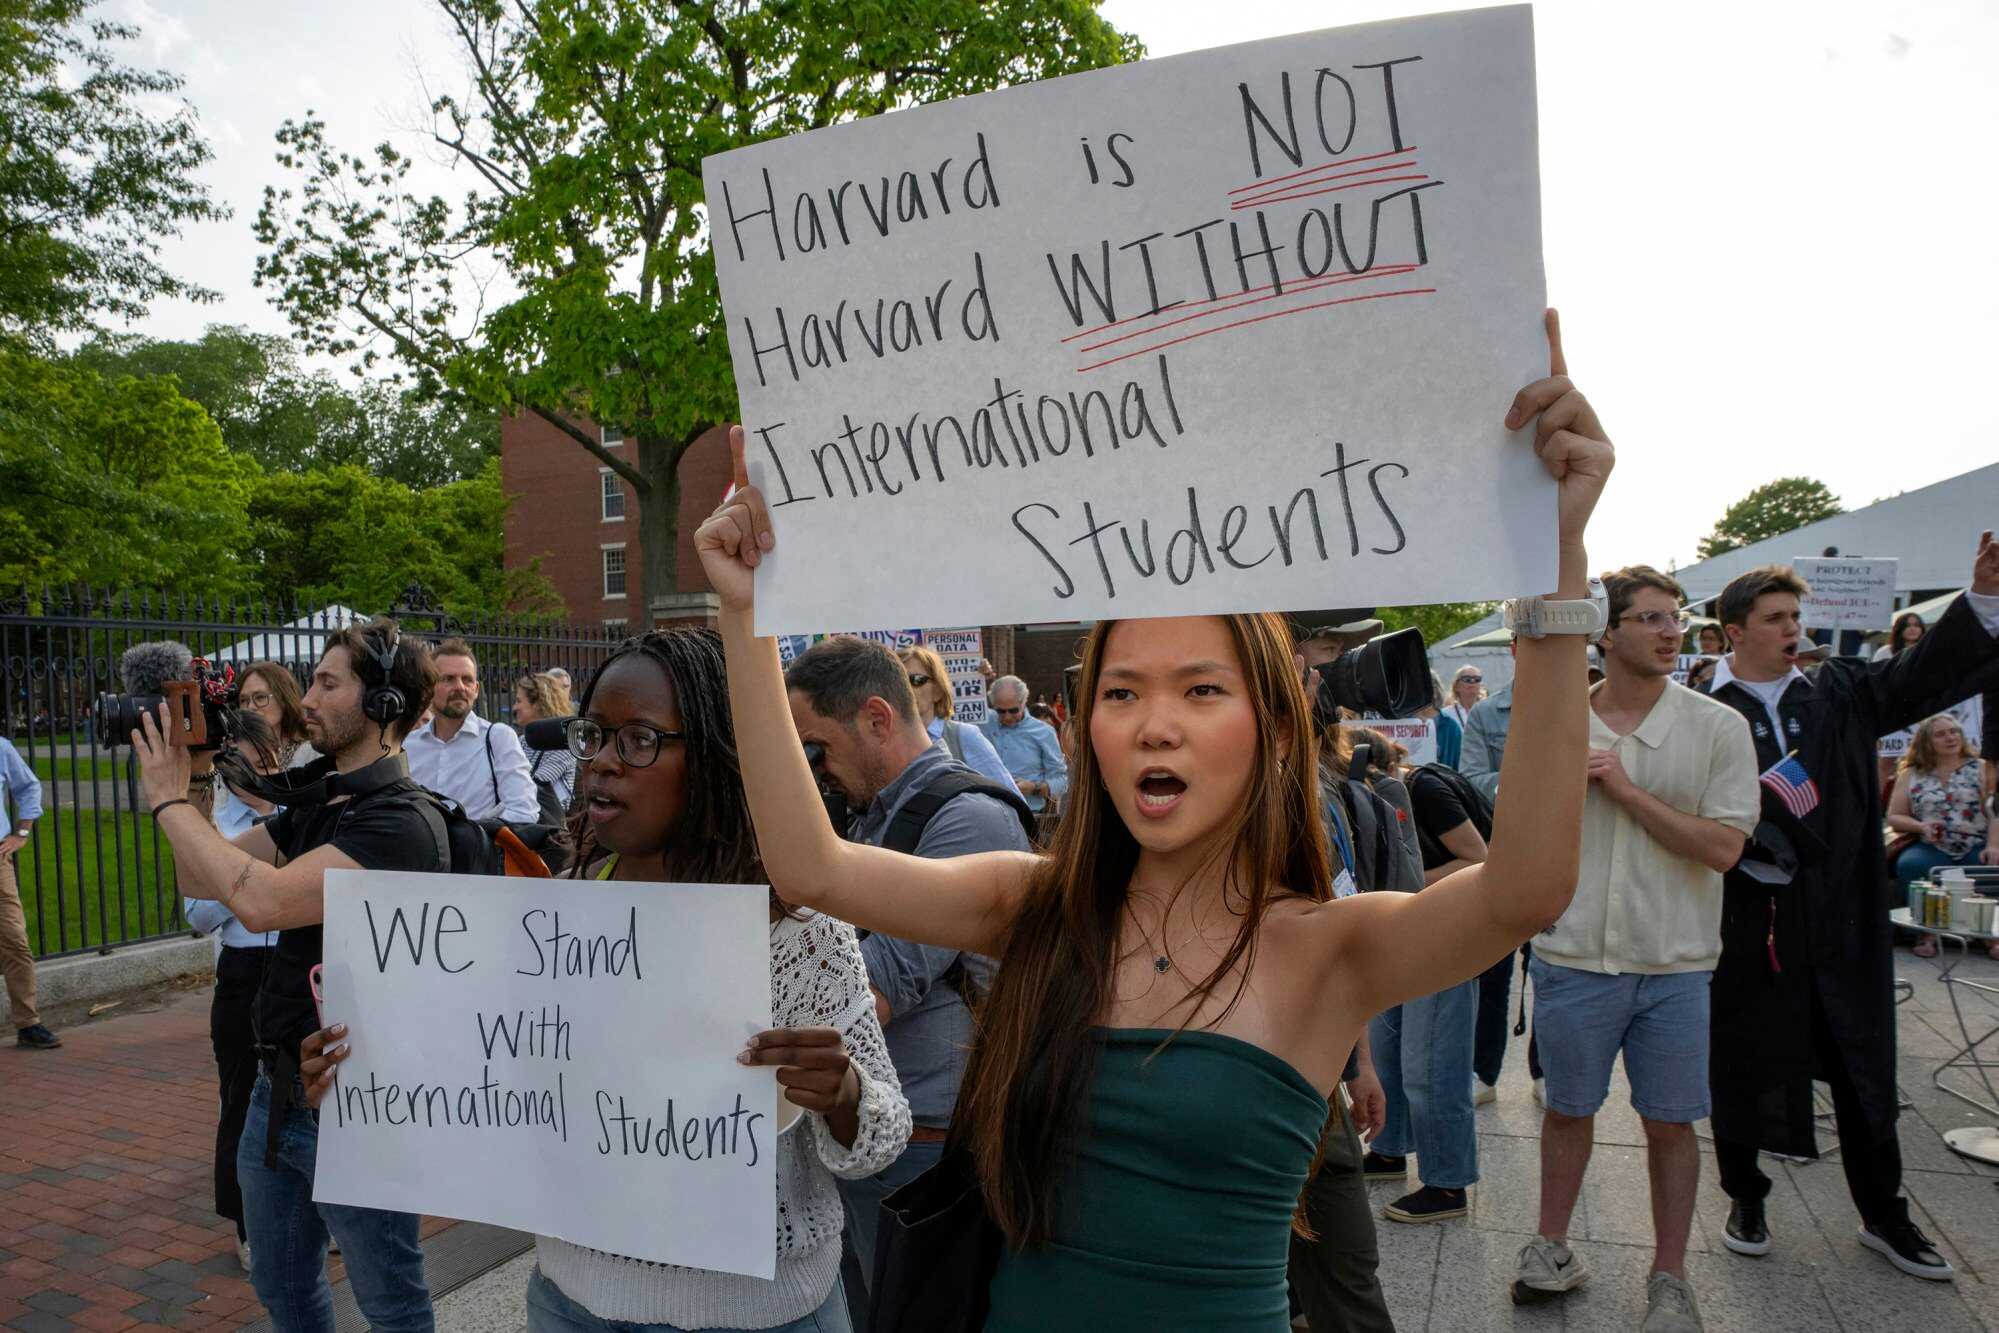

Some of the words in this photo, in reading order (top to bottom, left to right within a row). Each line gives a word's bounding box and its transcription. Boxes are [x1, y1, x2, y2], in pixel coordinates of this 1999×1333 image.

[722, 131, 1001, 262] Harvard
[1080, 131, 1135, 188] is
[1237, 55, 1424, 178] NOT
[745, 251, 1001, 387] Harvard
[1045, 179, 1445, 329] WITHOUT
[752, 354, 1186, 508] International
[1011, 441, 1410, 599] Students
[928, 632, 978, 644] PERSONAL
[937, 643, 968, 653] DATA
[953, 703, 982, 713] EAN
[363, 899, 475, 974] We
[516, 905, 643, 981] Stand
[476, 1003, 571, 1061] With
[333, 1064, 567, 1142] International
[594, 1088, 765, 1168] Students
